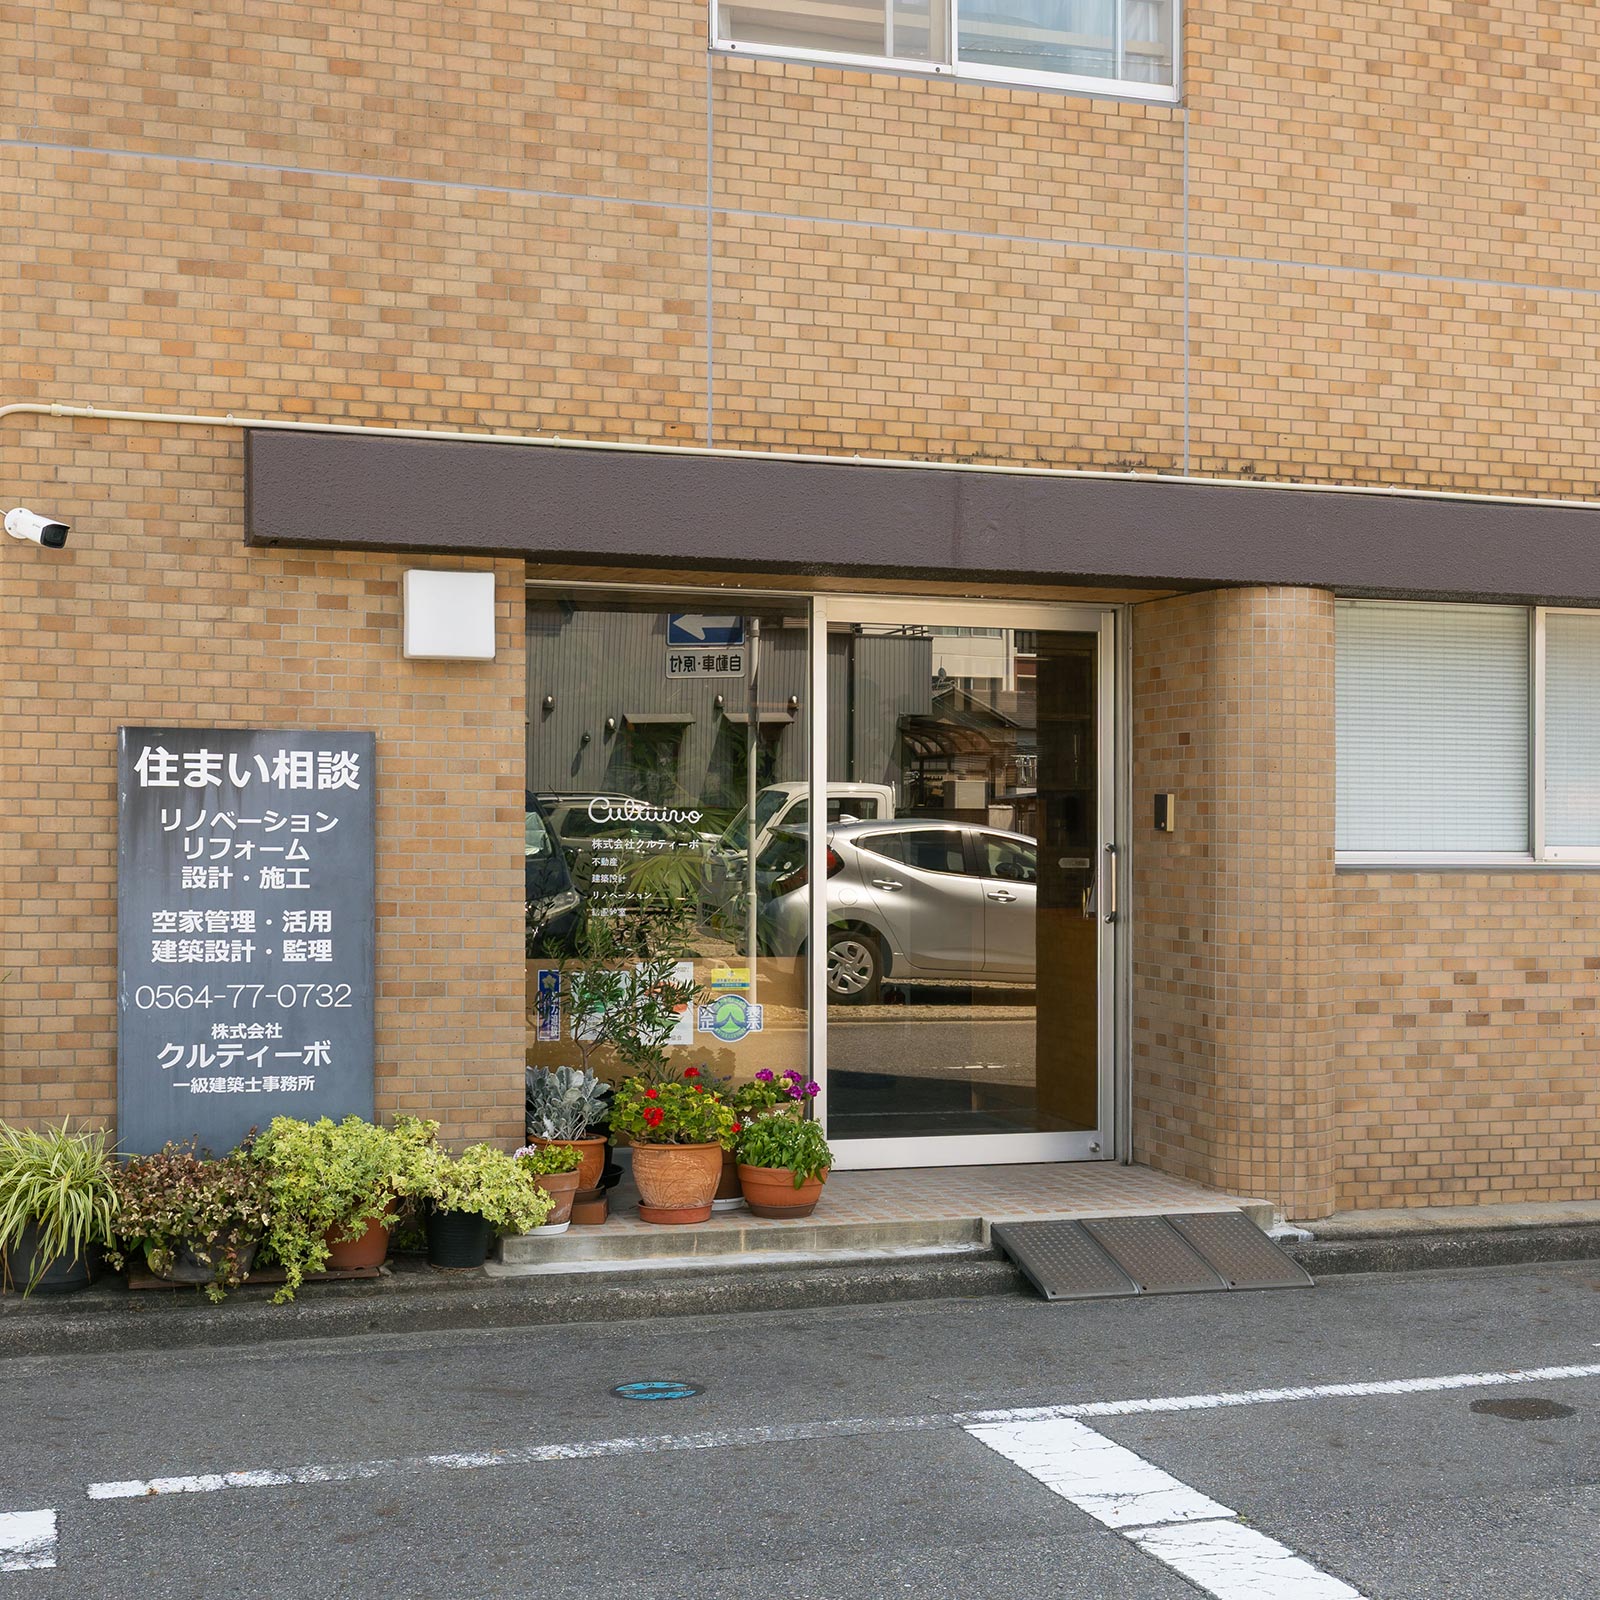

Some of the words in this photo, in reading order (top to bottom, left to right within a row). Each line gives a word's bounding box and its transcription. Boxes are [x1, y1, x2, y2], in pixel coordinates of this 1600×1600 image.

[133, 745, 361, 791] 住まい相談
[161, 808, 339, 834] リノベーション
[184, 837, 310, 861] リフォーム
[591, 838, 700, 850] 株式会社クルティーボ
[591, 857, 618, 867] 不動産
[181, 865, 311, 890] 設計・施工
[151, 909, 332, 934] 空家管理・活用
[151, 938, 333, 964] 建築設計・監理
[135, 983, 353, 1010] 0564-77-0732
[211, 1022, 283, 1040] 株式会社
[157, 1041, 332, 1070] クルティーボ
[172, 1074, 316, 1094] 一級建築士事務所
